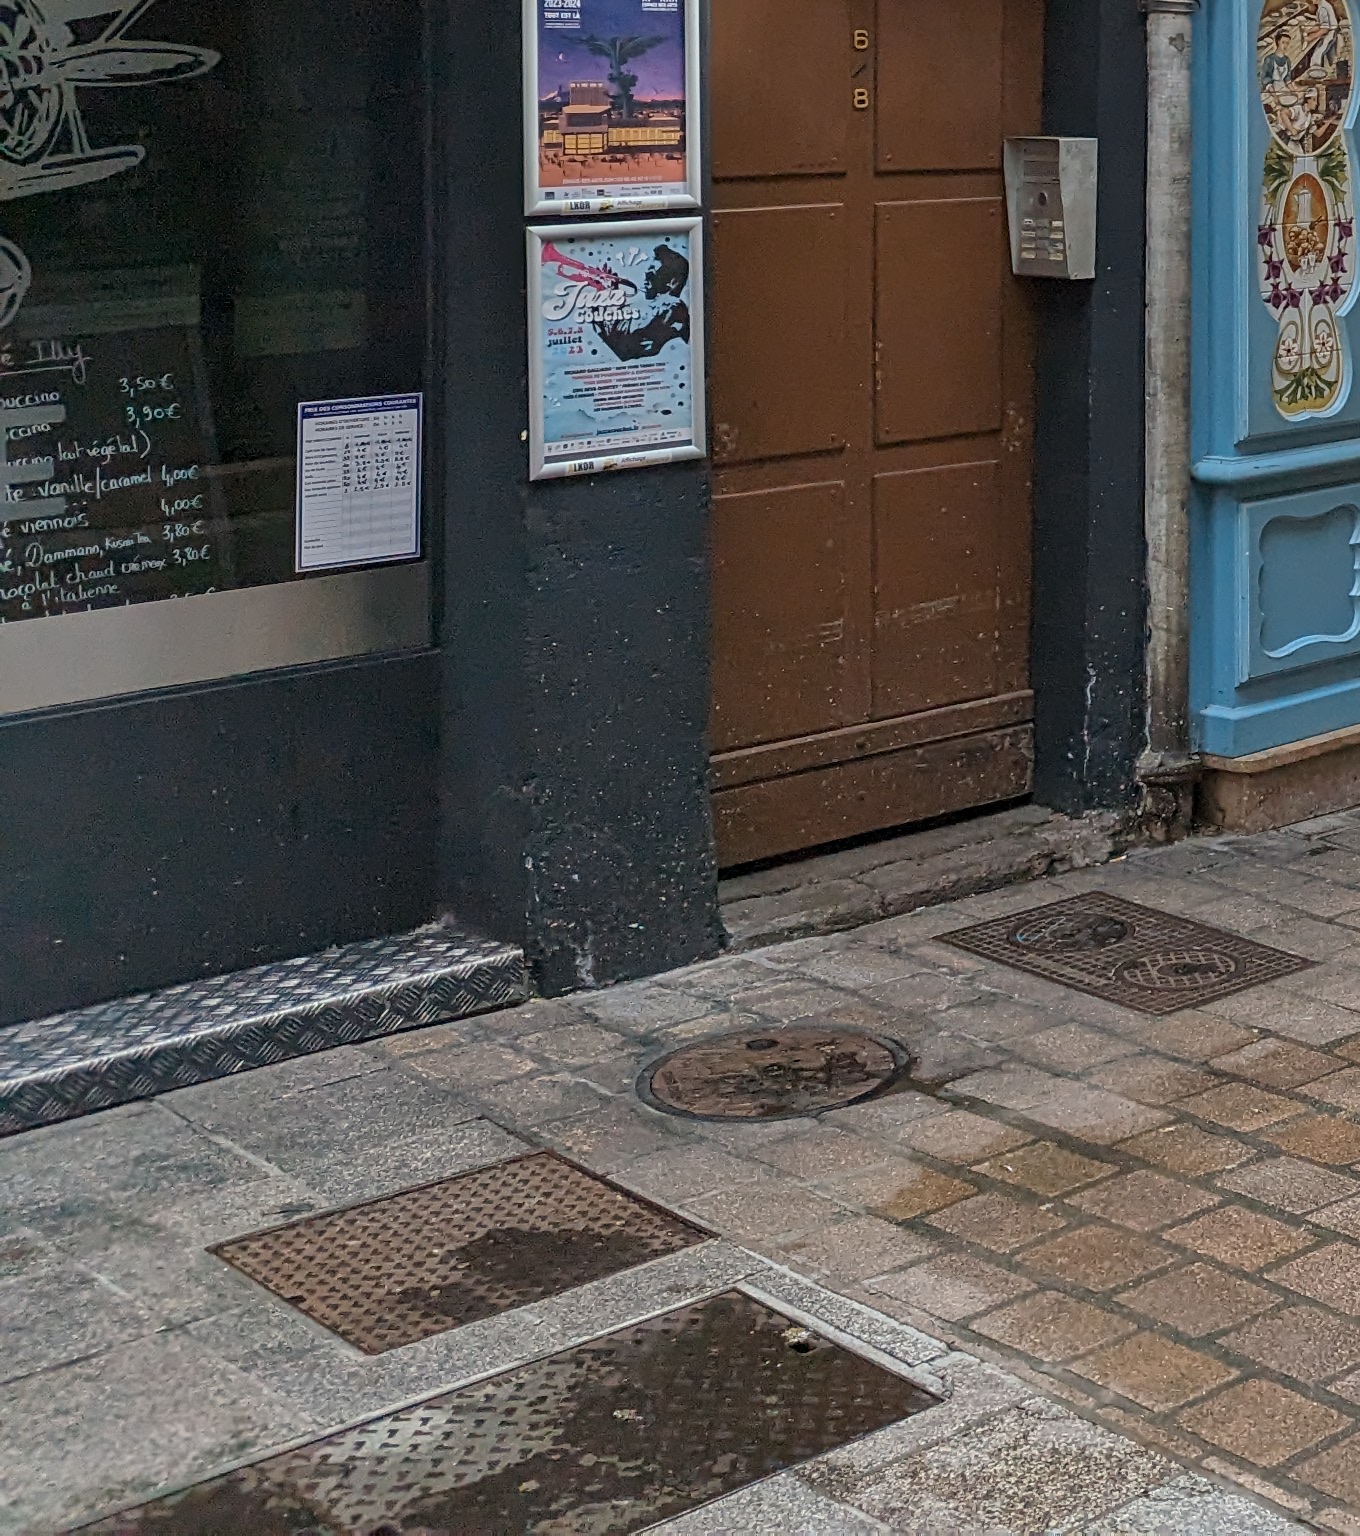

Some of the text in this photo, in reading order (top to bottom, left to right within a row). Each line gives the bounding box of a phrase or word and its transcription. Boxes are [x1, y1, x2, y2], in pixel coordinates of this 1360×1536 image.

[542, 281, 627, 320] Jazz
[547, 335, 583, 346] juillet
[552, 345, 583, 355] 2023
